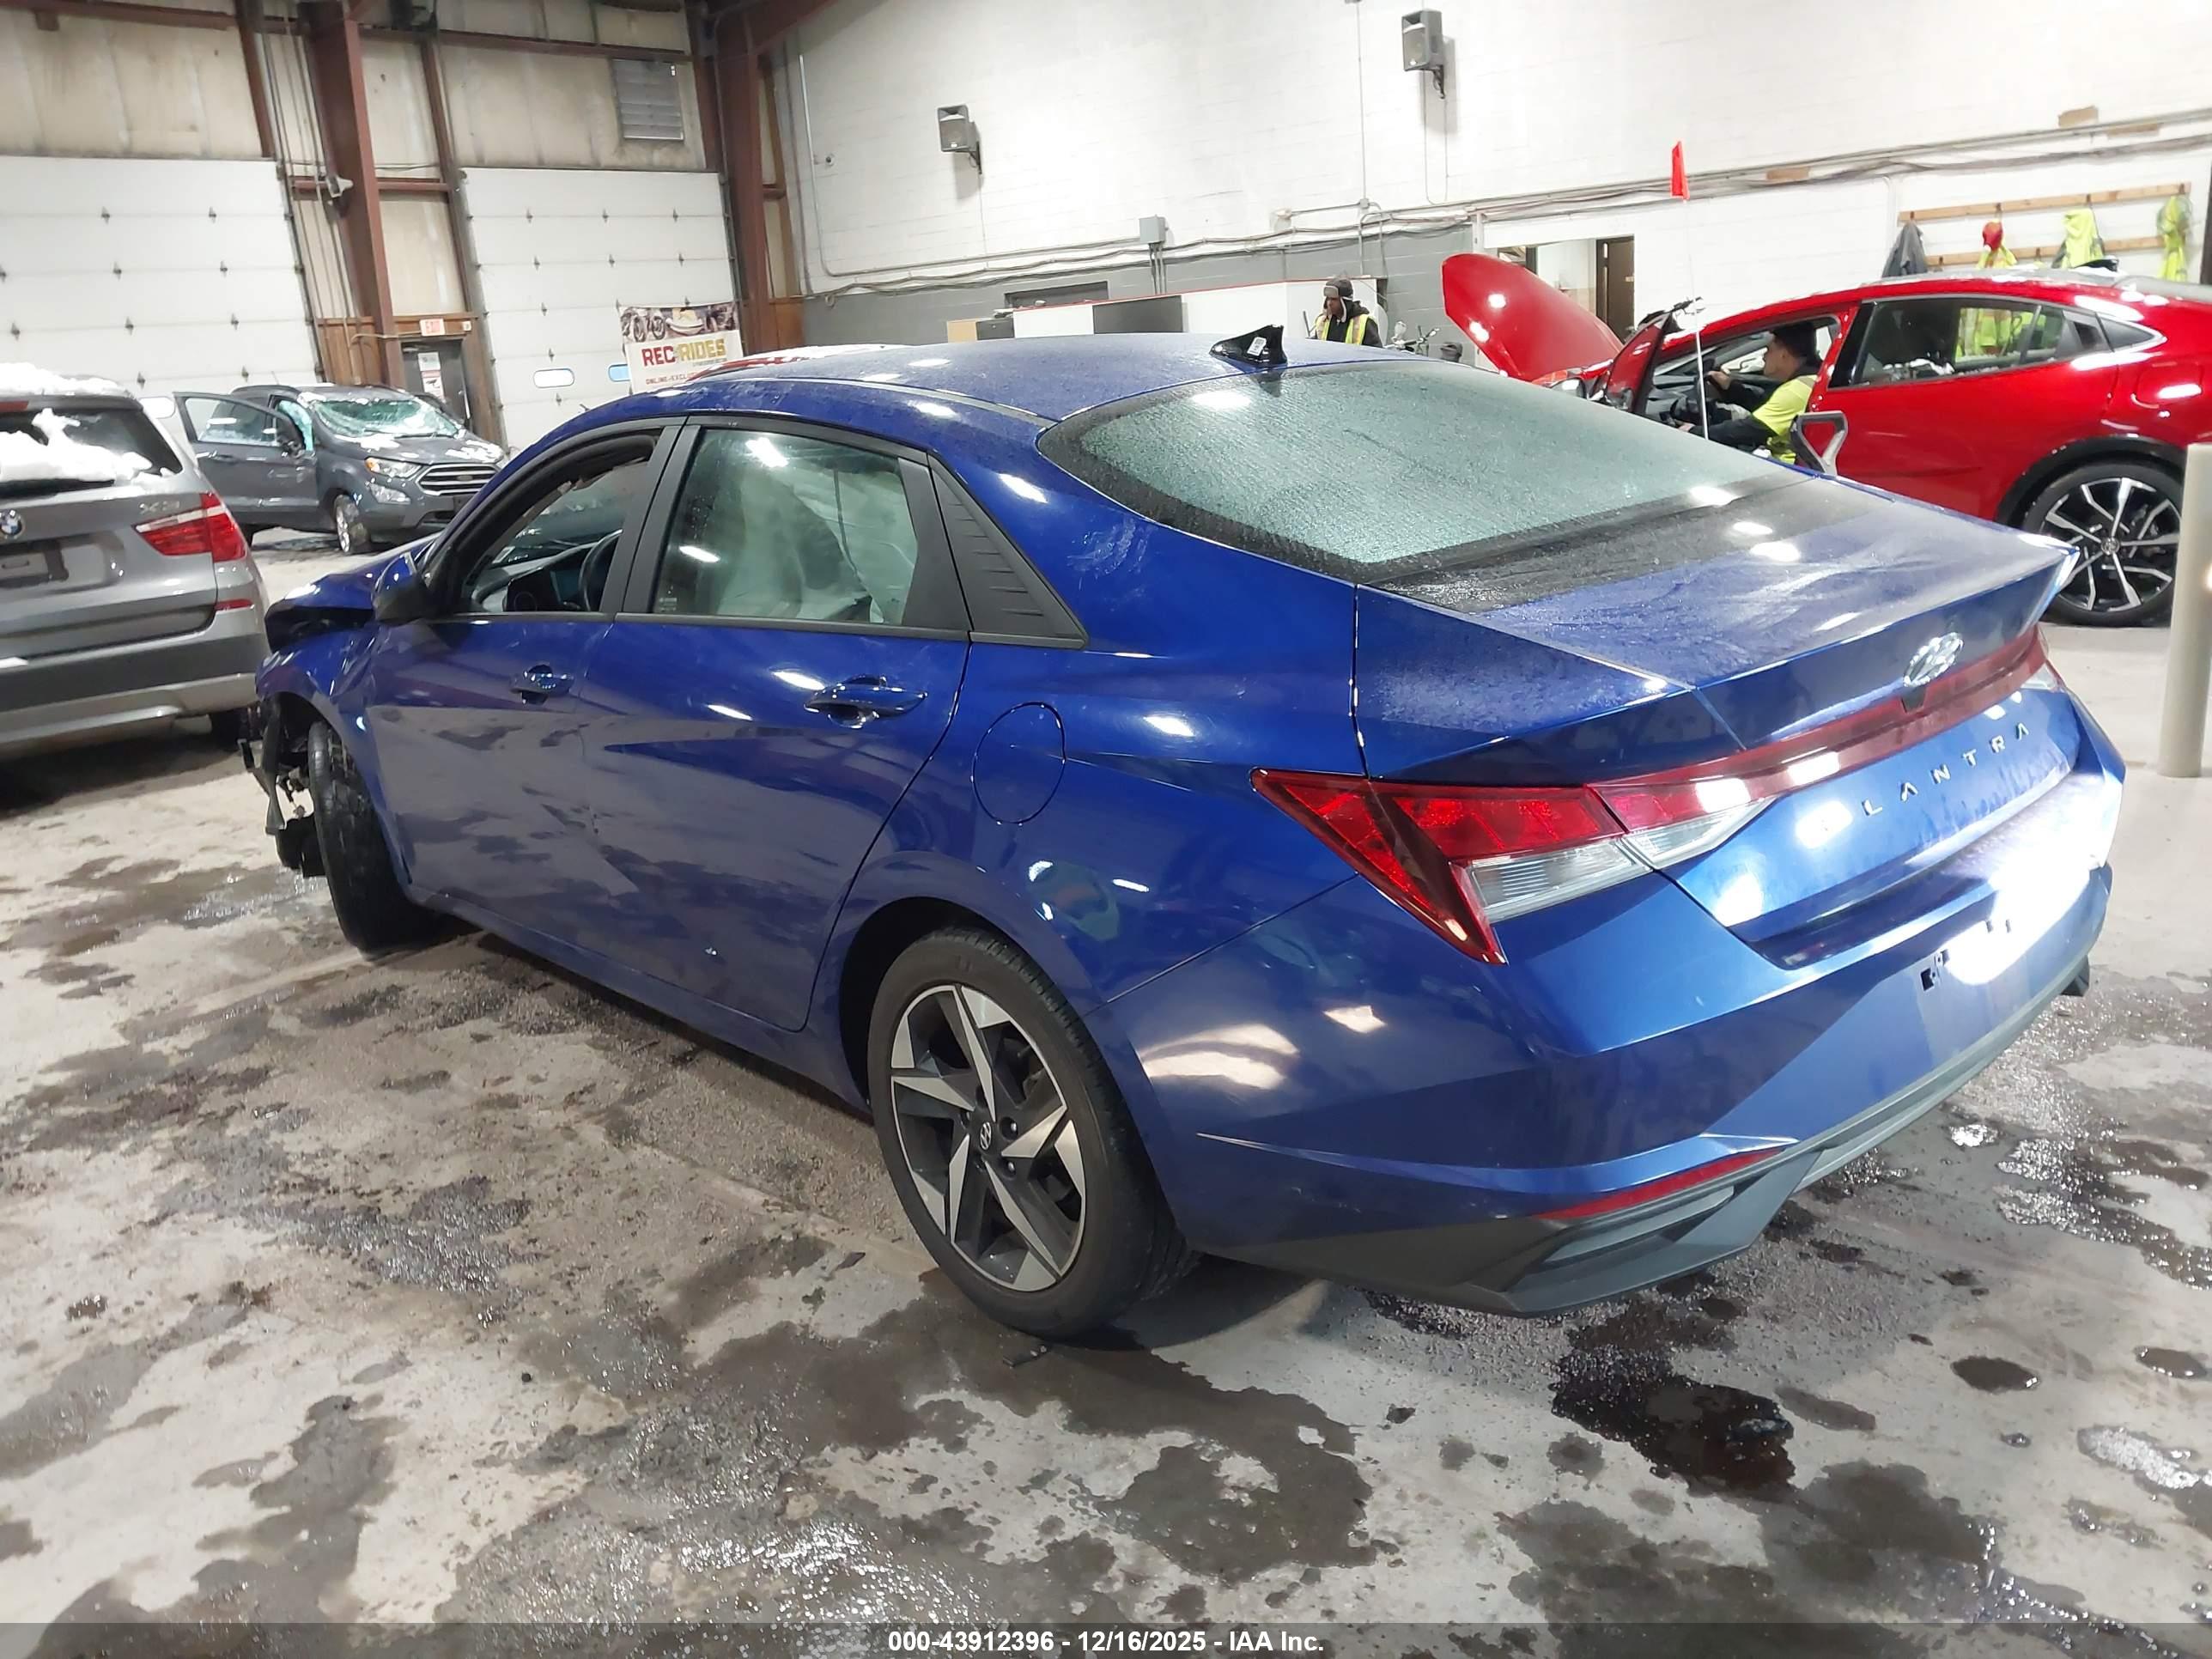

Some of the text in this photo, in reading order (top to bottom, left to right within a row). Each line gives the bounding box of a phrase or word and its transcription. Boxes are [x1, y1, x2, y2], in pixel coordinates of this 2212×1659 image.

[642, 346, 676, 366] REC
[679, 339, 726, 360] RIDES
[1821, 723, 2029, 830] LANTRA
